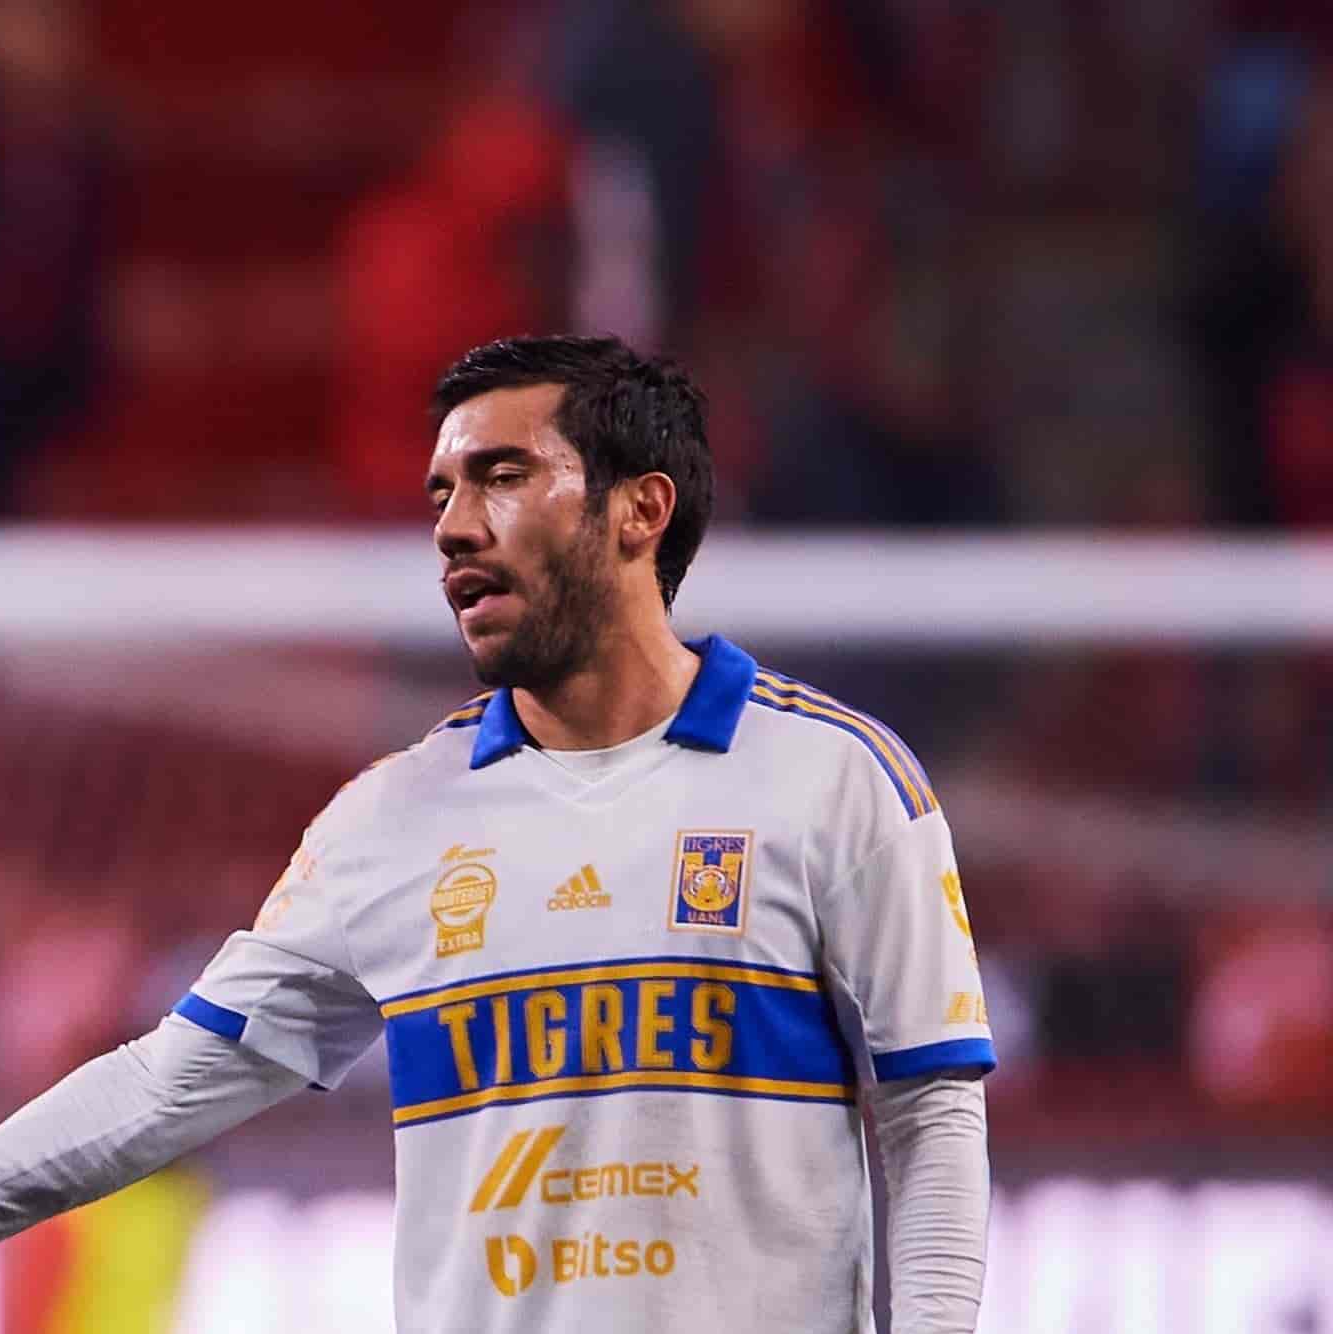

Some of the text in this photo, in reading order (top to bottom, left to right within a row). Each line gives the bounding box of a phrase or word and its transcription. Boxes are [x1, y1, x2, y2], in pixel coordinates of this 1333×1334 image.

[438, 982, 735, 1089] TIGRES
[539, 1161, 700, 1202] CEMEX
[551, 1233, 675, 1283] Bitso
